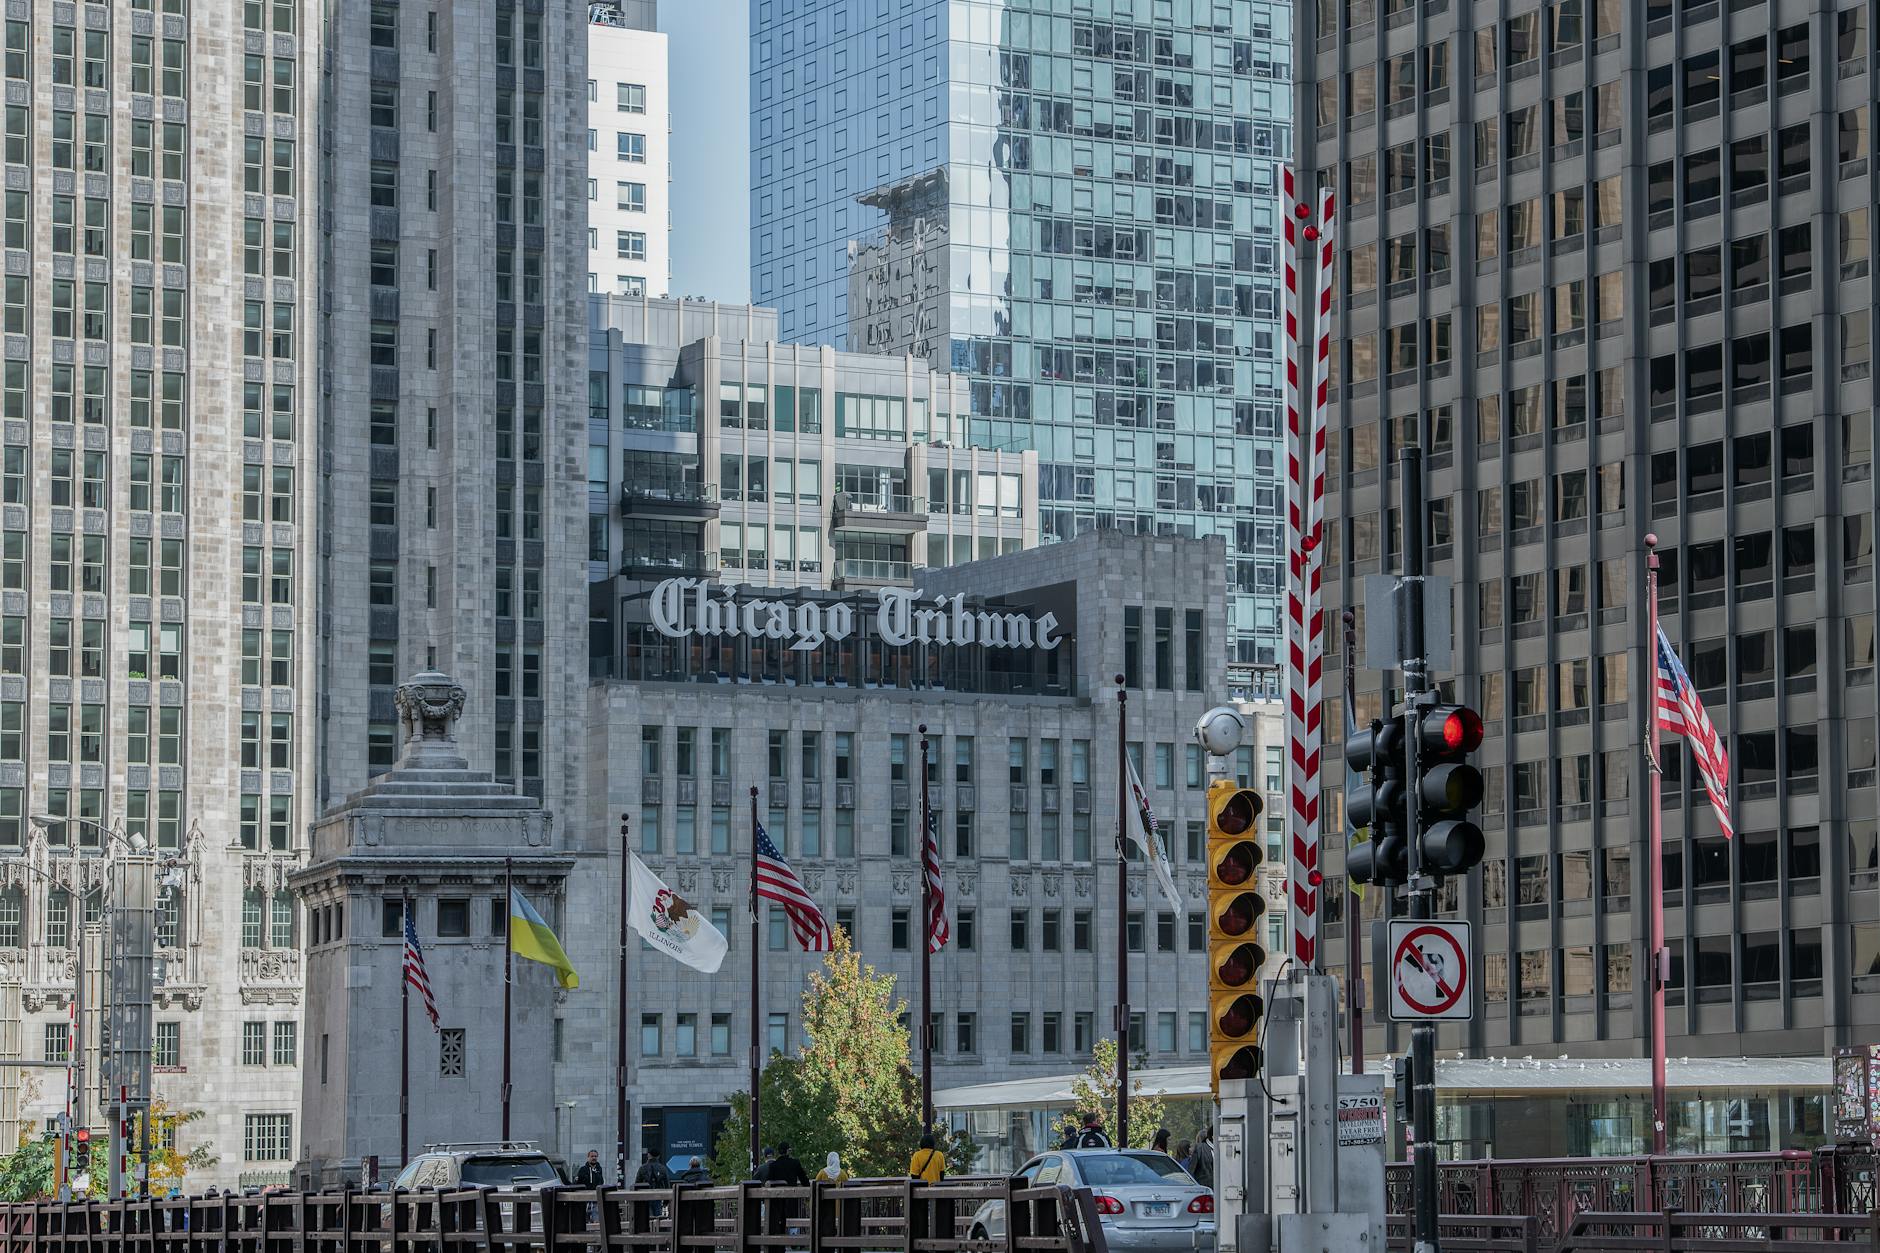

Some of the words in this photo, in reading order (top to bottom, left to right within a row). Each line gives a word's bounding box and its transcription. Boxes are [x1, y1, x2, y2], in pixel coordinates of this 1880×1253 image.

[650, 577, 854, 651] Chicago
[877, 586, 1063, 651] Tribune
[395, 821, 449, 833] OPENED
[461, 822, 512, 833] MCMXX
[649, 931, 682, 953] ILLINOIS
[1339, 1097, 1378, 1108] $750
